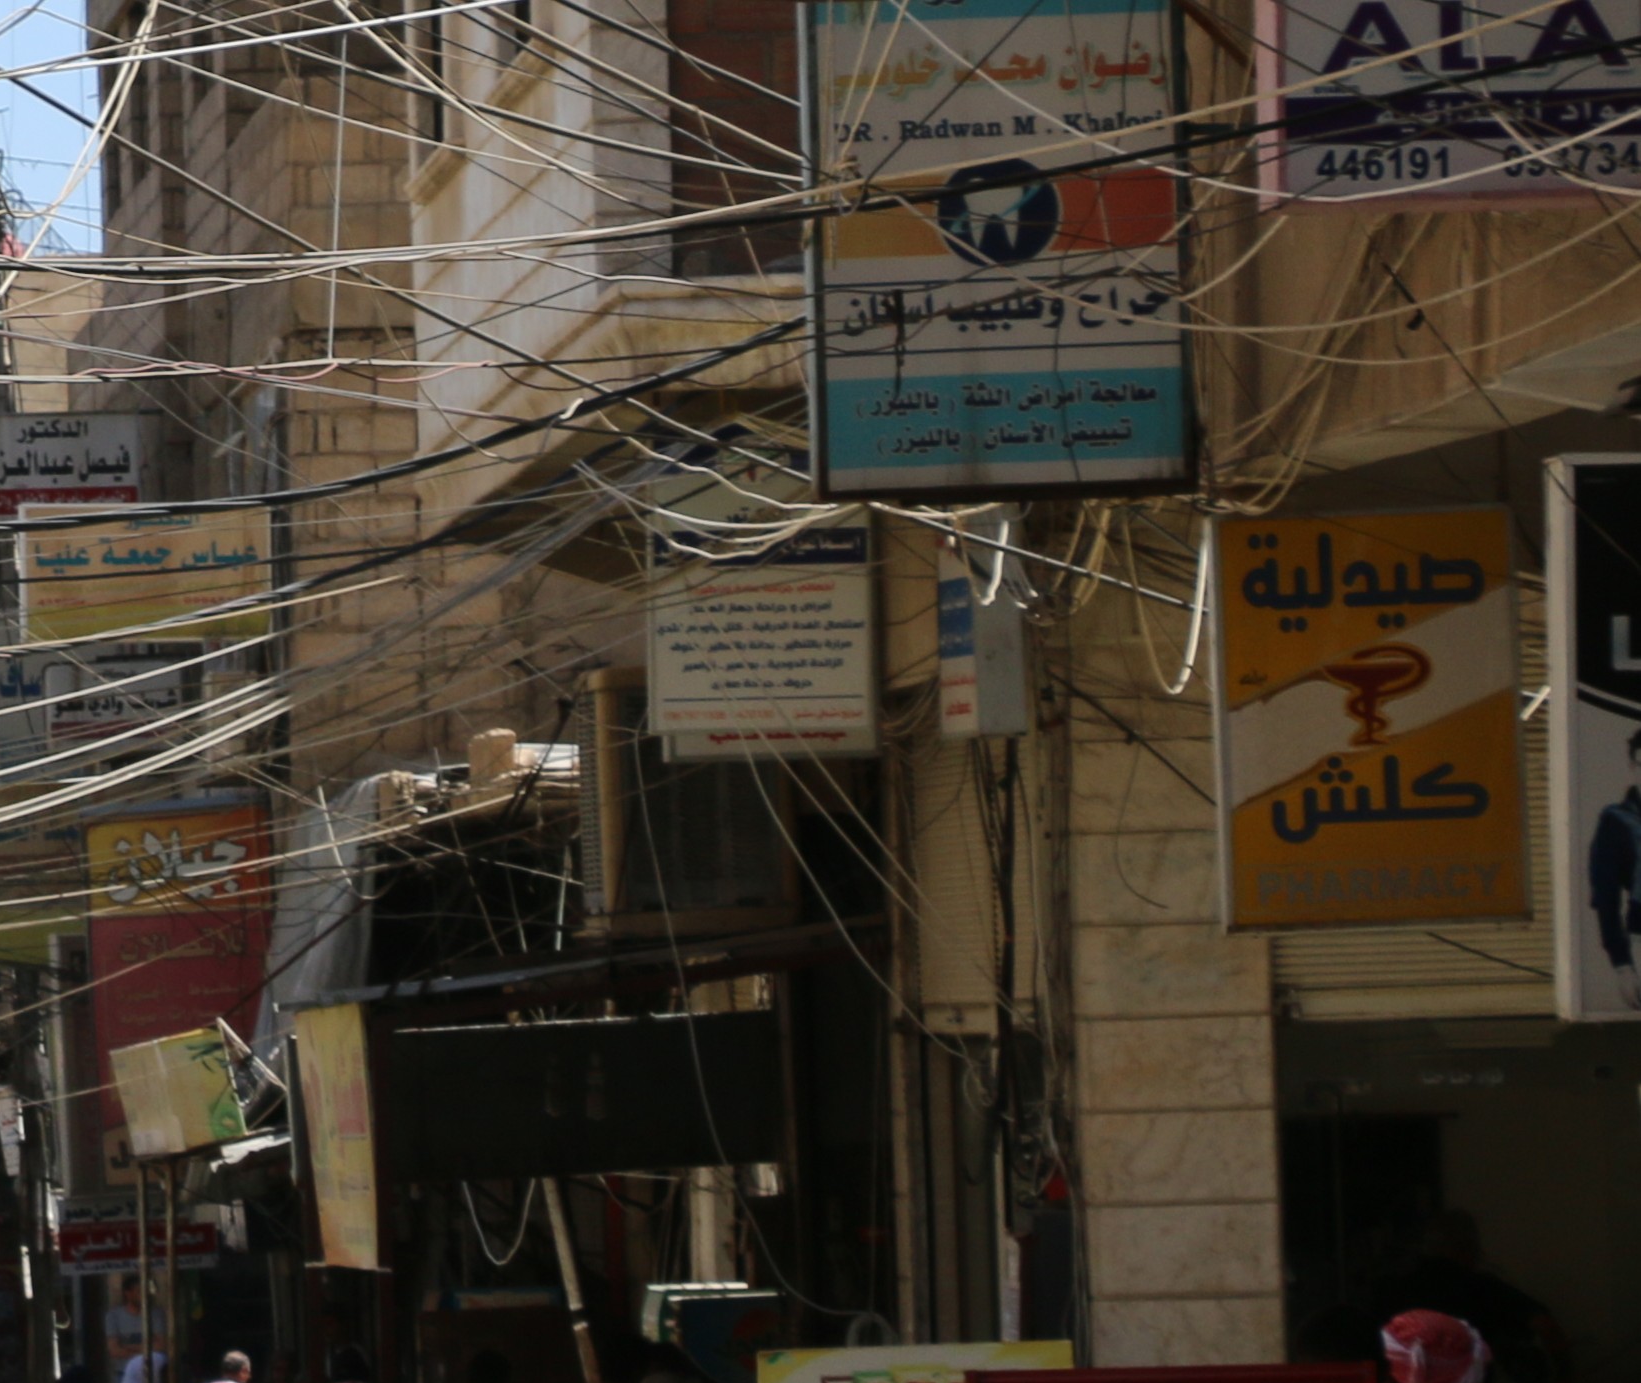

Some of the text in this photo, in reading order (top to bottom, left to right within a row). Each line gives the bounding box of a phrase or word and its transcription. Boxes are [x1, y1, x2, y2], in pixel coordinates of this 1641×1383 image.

[898, 118, 1003, 141] Radwan
[1317, 146, 1450, 181] 446191
[1078, 287, 1171, 328] جراح
[16, 419, 88, 443] الدكتور
[77, 445, 131, 481] فيصل
[1240, 531, 1486, 635] صيدلية
[1270, 753, 1491, 845] كلش
[1257, 860, 1503, 903] PHARMACY
